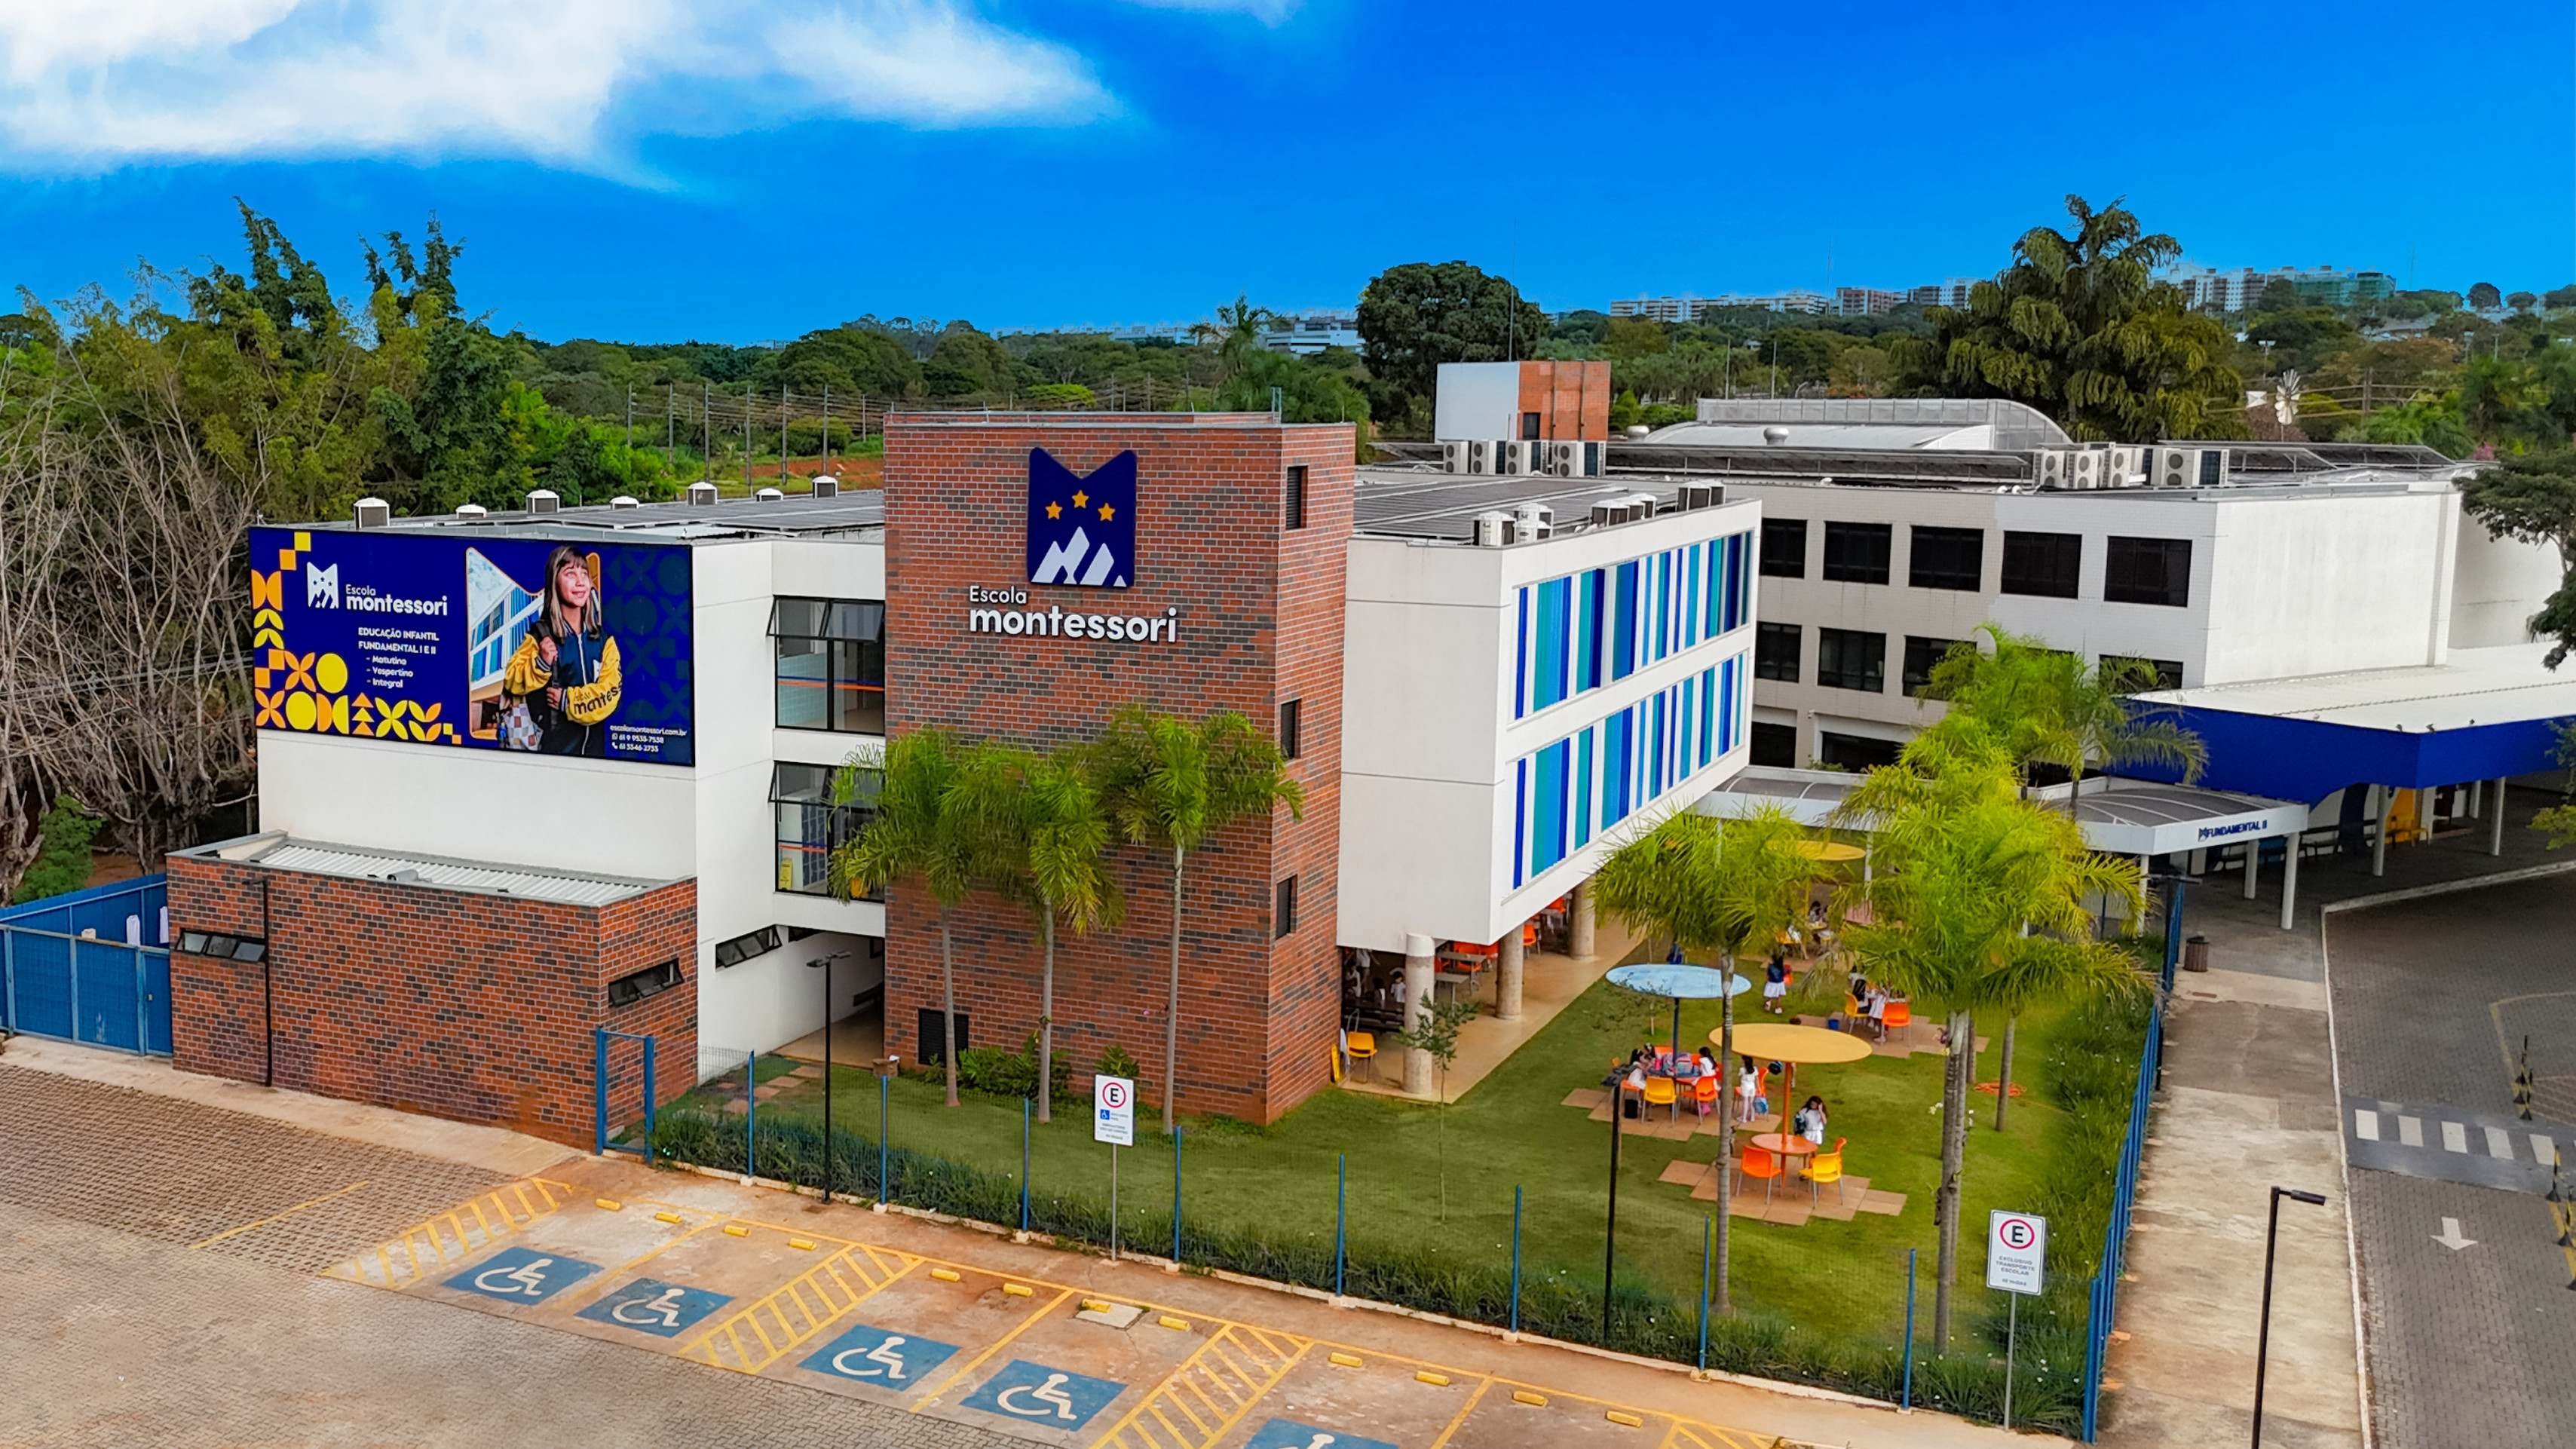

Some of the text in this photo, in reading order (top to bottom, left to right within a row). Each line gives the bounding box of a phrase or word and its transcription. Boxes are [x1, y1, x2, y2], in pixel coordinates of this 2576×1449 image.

[345, 584, 376, 596] Escola
[969, 585, 1028, 604] Escola
[346, 593, 448, 616] montessori
[969, 605, 1177, 642] montessori
[358, 627, 440, 641] EDUCAÇÃO INFANTIL
[358, 641, 418, 654] FUNDAMENTAL
[424, 645, 430, 654] E
[372, 655, 407, 665] Matutino
[372, 666, 414, 678] Vespertino
[372, 678, 403, 689] Integral
[2207, 821, 2260, 837] FUNDAMENTAL
[1110, 1088, 1119, 1103] E
[2012, 1226, 2024, 1243] E
[1996, 1261, 2035, 1271] TRANSPORTE
[1999, 1256, 2032, 1264] EXCLUSIVO
